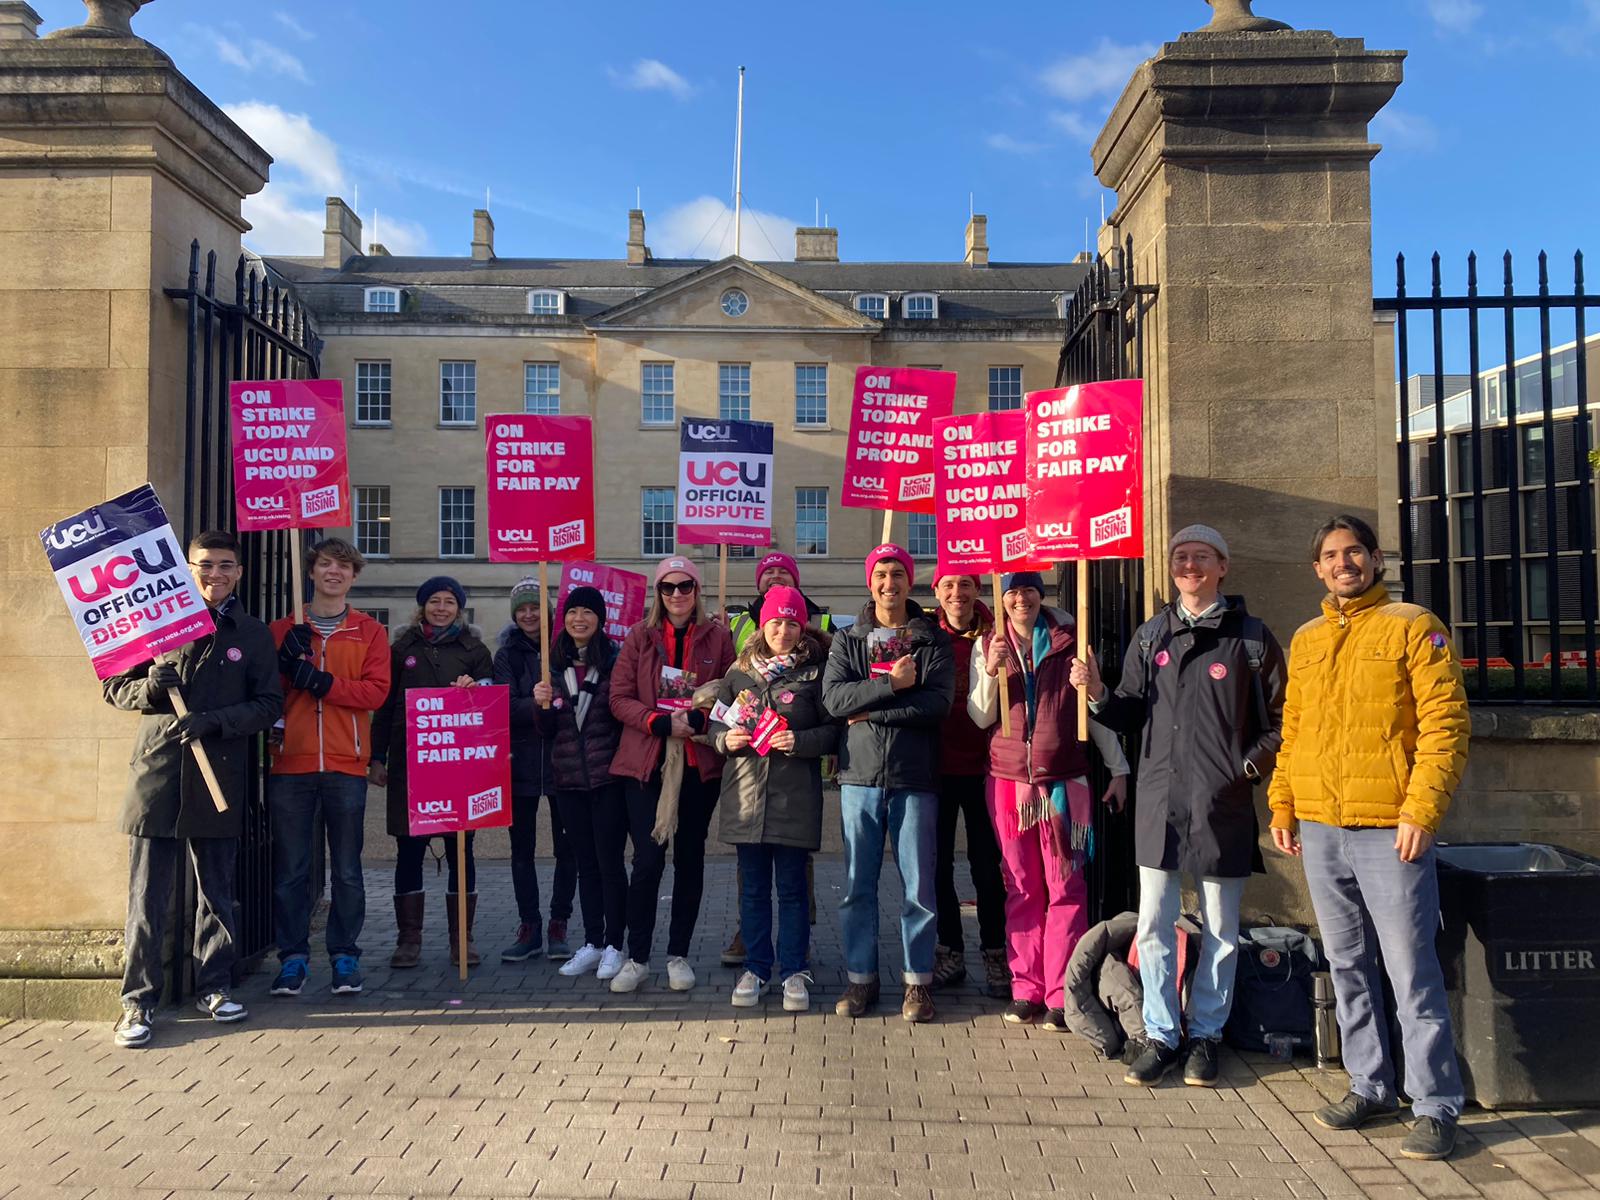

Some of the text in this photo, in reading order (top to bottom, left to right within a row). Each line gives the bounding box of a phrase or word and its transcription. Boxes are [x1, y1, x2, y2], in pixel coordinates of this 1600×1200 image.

[864, 376, 890, 389] ON
[241, 390, 271, 404] ON
[862, 392, 928, 408] STRIKE
[242, 407, 316, 422] STRIKE
[1037, 400, 1066, 417] ON
[860, 409, 921, 425] TODAY
[242, 425, 311, 440] TODAY
[496, 424, 523, 438] ON
[943, 426, 972, 442] ON
[1037, 414, 1111, 438] STRIKE
[858, 430, 896, 445] UCU
[244, 447, 334, 462] UCU AND
[496, 442, 566, 455] STRIKE
[856, 447, 919, 464] PROUD
[944, 440, 1017, 461] STRIKE
[1037, 439, 1077, 459] FOR
[246, 465, 317, 480] PROUD
[496, 459, 535, 473] FOR
[944, 460, 1012, 480] TODAY
[1037, 454, 1128, 479] FAIR PAY
[497, 477, 580, 490] FAIR PAY
[903, 484, 930, 497] RISING
[686, 489, 765, 504] OFFICIAL
[946, 483, 1026, 504] UCU AN
[306, 496, 335, 514] RISING
[685, 505, 764, 520] DISPUTE
[947, 504, 1018, 523] PROUD
[553, 530, 580, 547] RISING
[1095, 521, 1126, 542] RISING
[570, 568, 594, 583] ON
[83, 573, 186, 625] OFFICIAL
[91, 590, 194, 646] DISPUTE
[146, 621, 204, 649] www.ucu.org.uk
[416, 698, 443, 711] ON
[416, 713, 483, 729] STRIKE
[417, 732, 455, 746] FOR
[418, 746, 498, 763] FAIR PAY
[472, 798, 498, 816] RISING
[1505, 950, 1595, 970] LITTER
